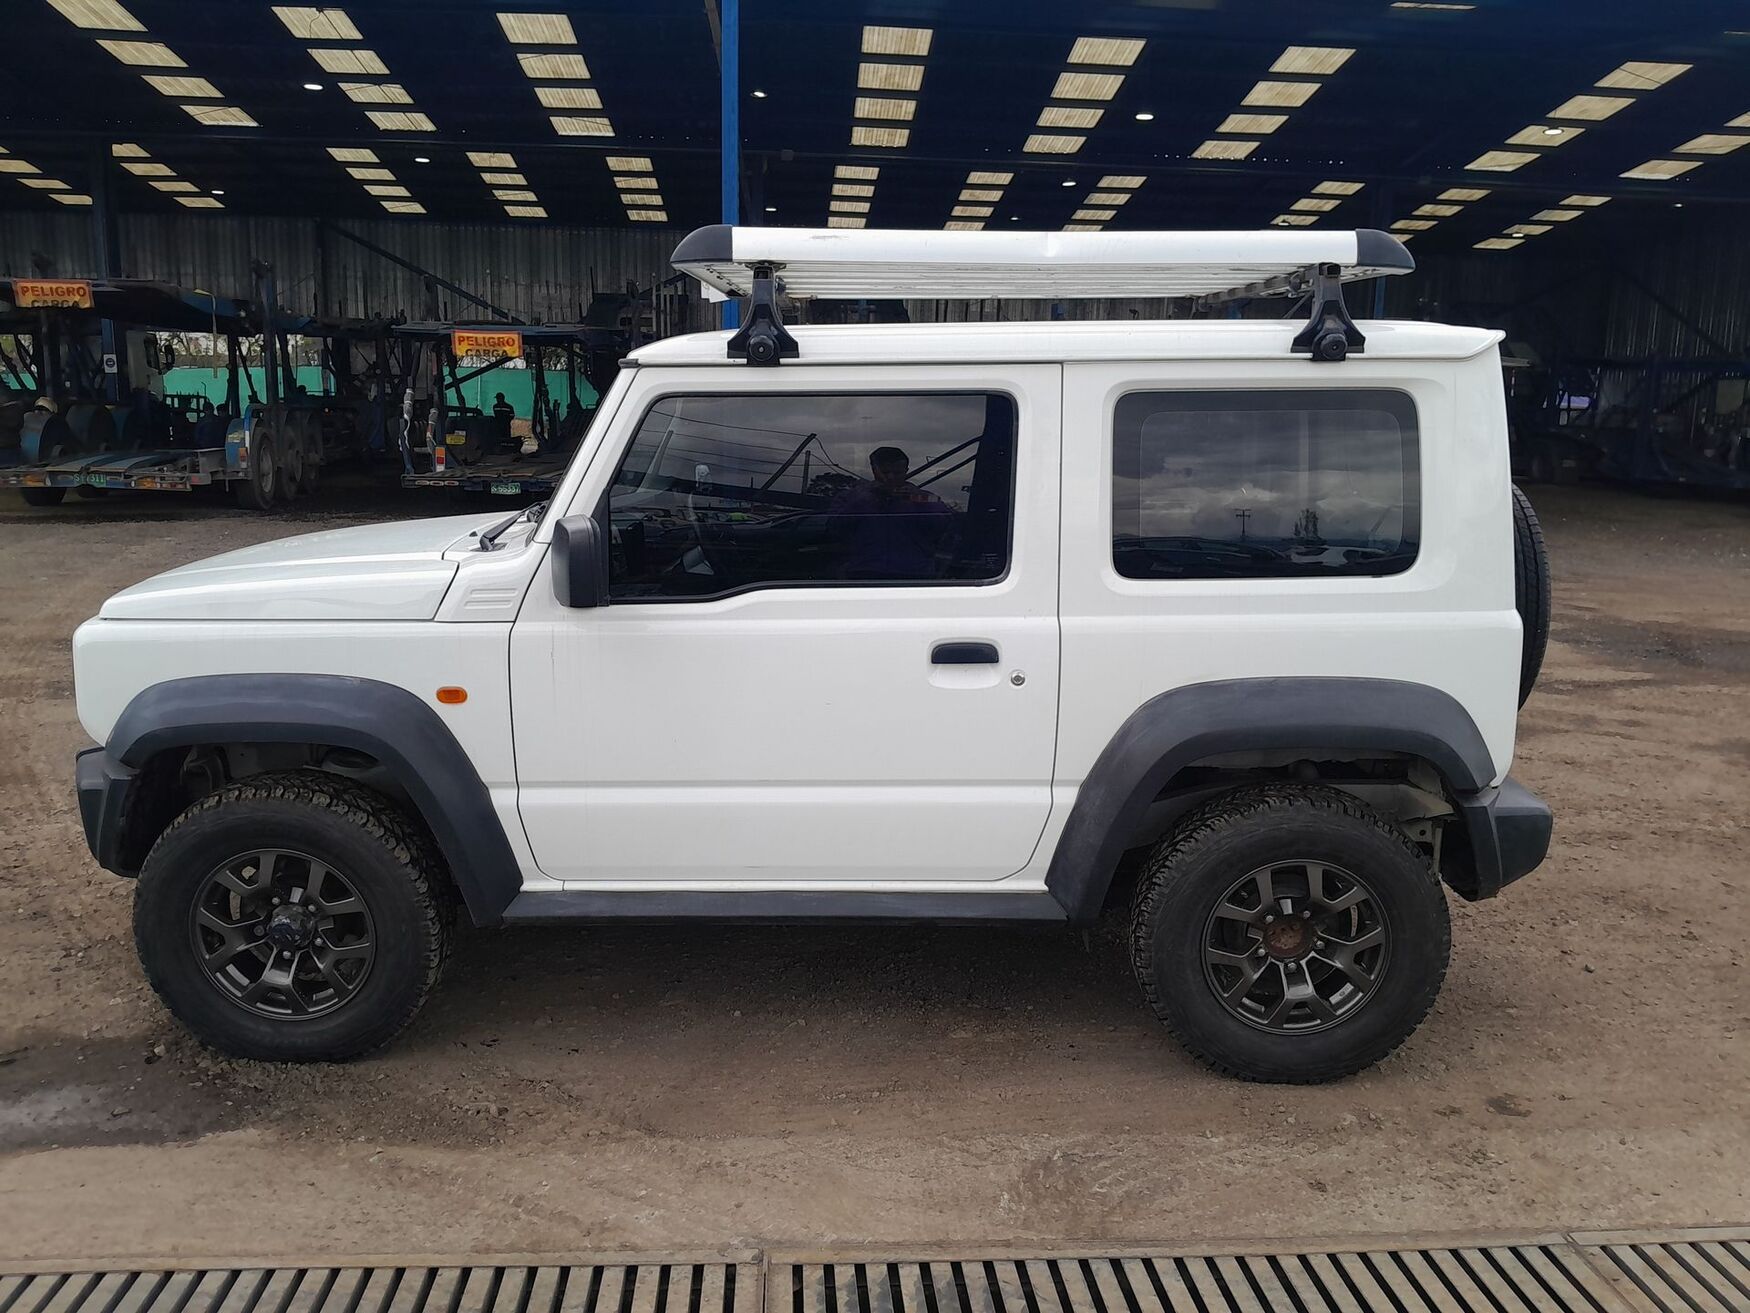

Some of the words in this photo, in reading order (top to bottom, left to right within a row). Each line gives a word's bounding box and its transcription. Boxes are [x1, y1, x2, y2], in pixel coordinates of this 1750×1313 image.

[20, 285, 87, 297] PELIGRO
[457, 335, 516, 347] PELIGRO
[465, 348, 509, 358] CARGA
